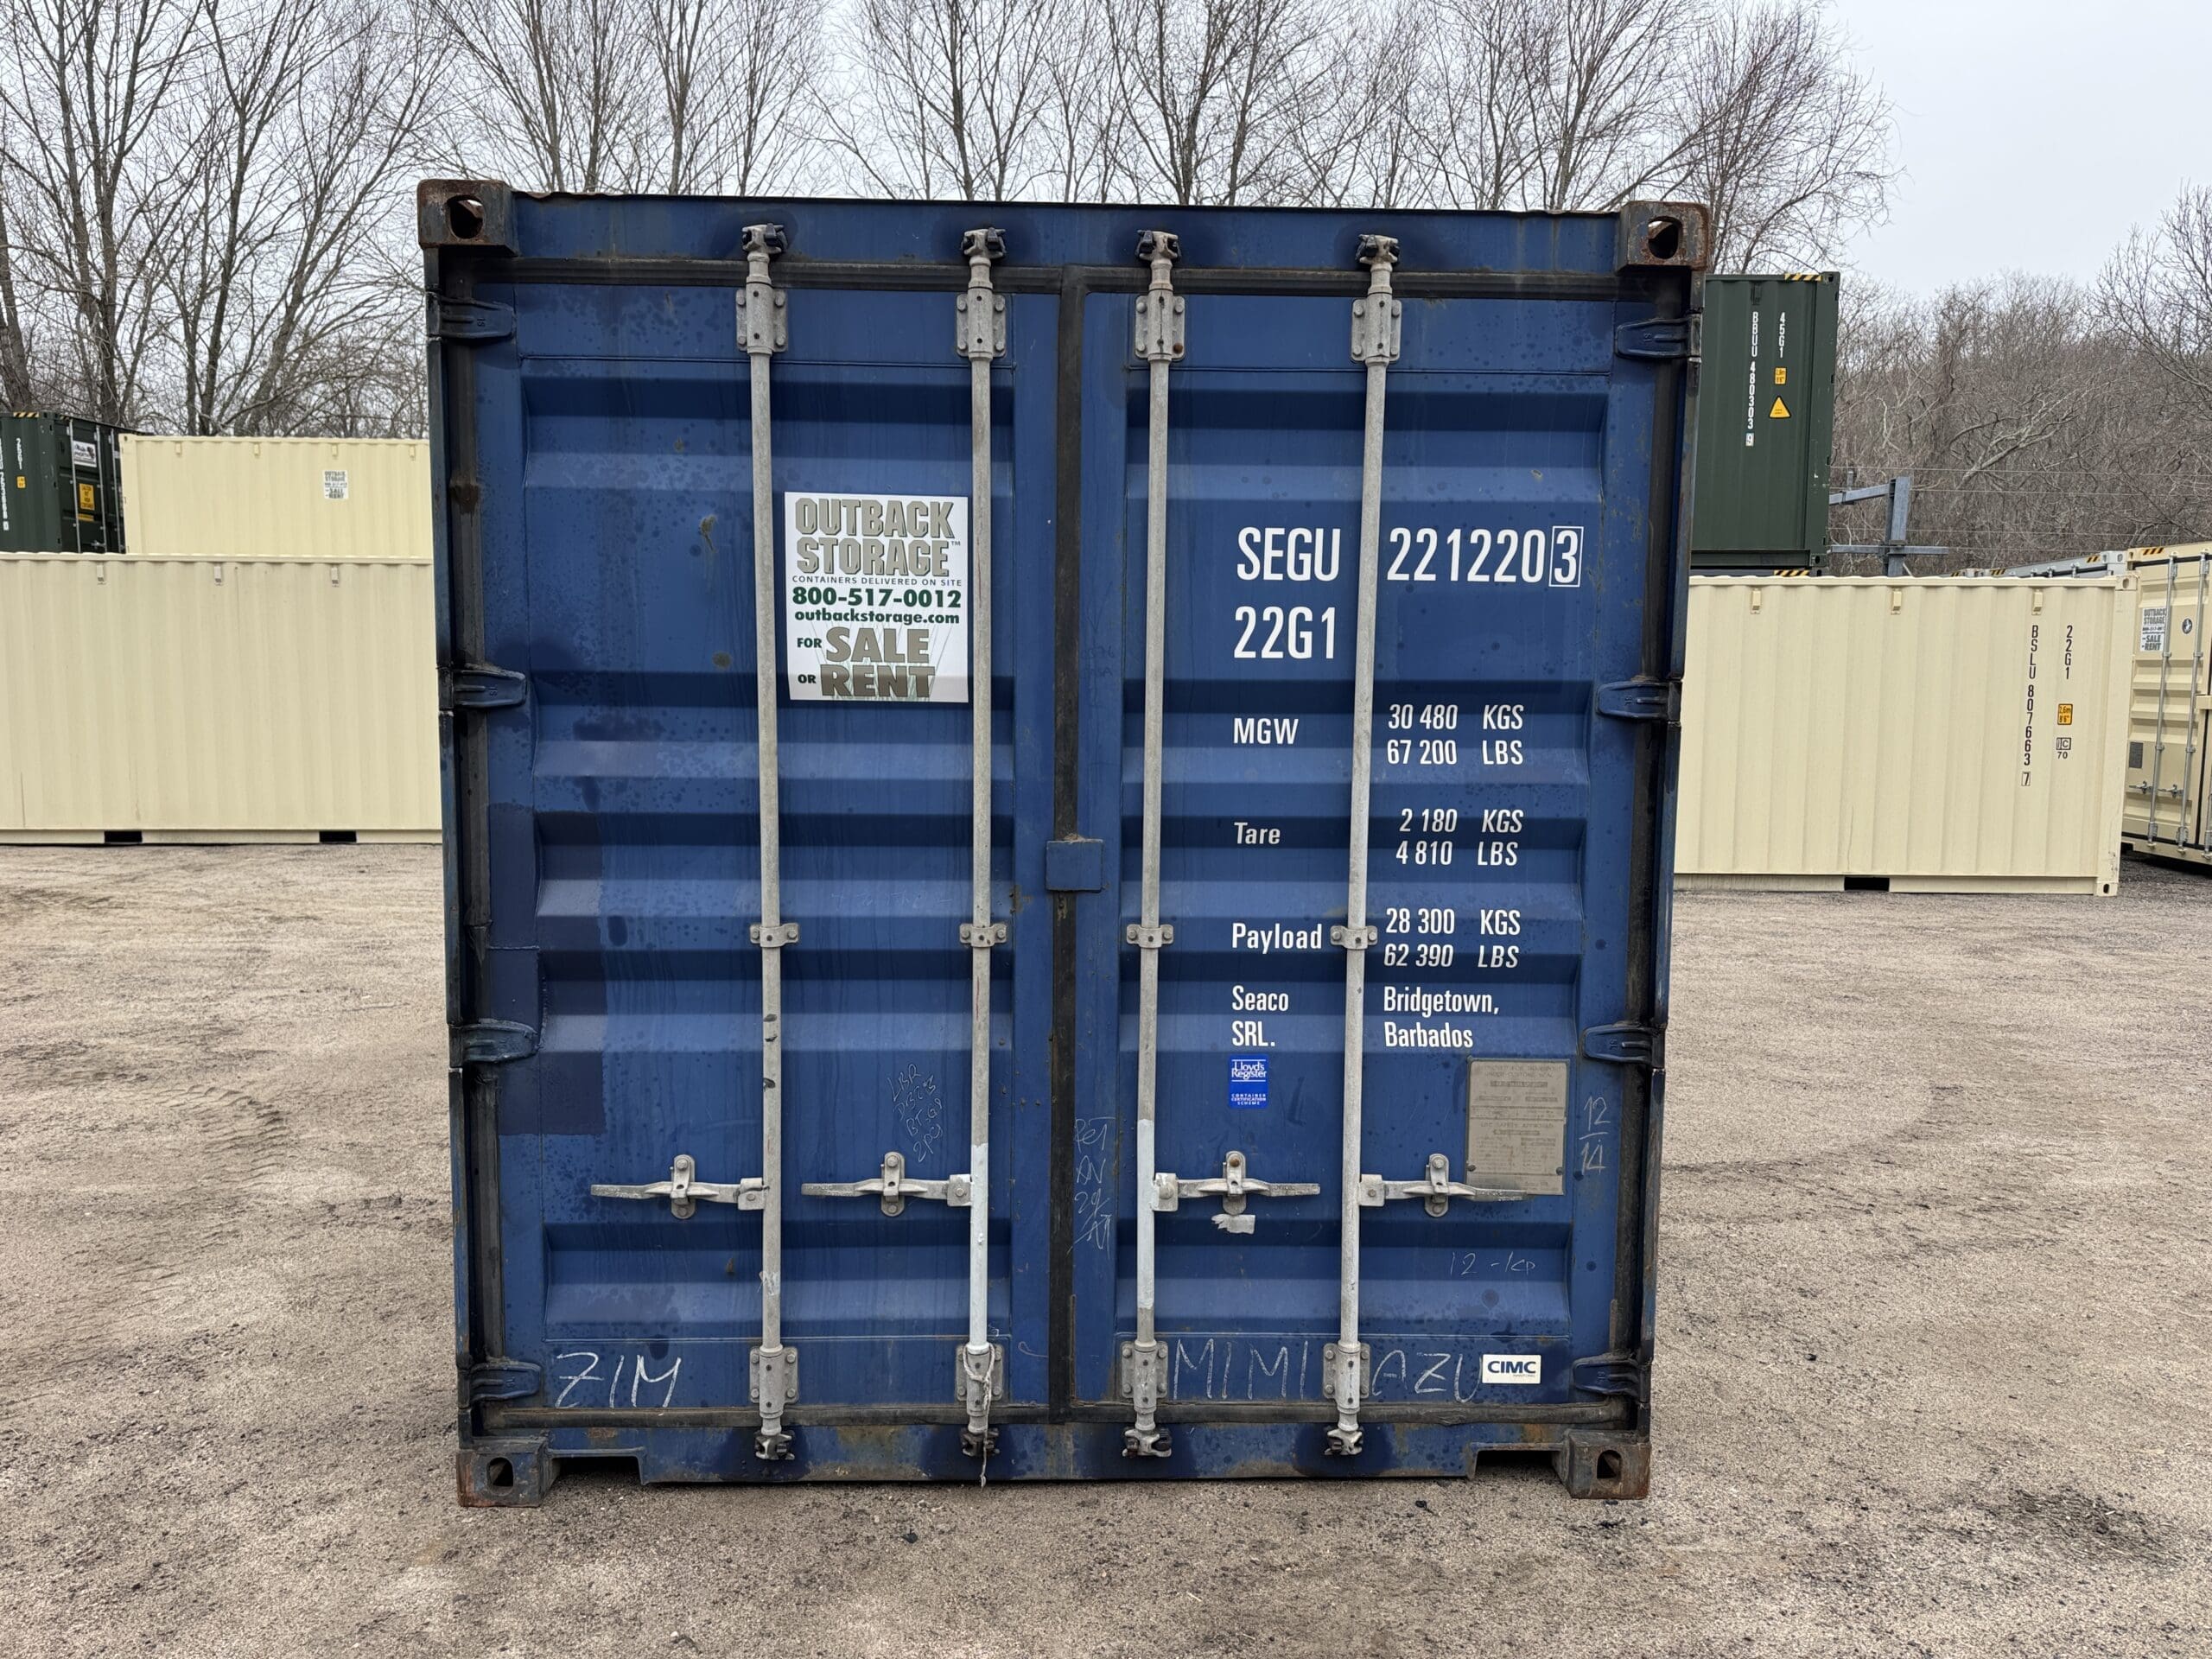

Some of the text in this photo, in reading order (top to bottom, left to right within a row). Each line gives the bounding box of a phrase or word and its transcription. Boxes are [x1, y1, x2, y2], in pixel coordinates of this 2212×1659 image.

[1747, 361, 1756, 429] 480303
[795, 498, 955, 538] OUTBACK
[797, 537, 949, 576] STORAGE
[1236, 527, 1341, 582] SEGU
[792, 575, 857, 584] CONTAINERS
[792, 587, 962, 608] 800-517-0012
[795, 608, 960, 626] outbackstorage.com
[797, 626, 930, 664] FOR SALE
[1234, 606, 1336, 659] 22G1
[2029, 625, 2039, 679] BSLU
[2064, 625, 2073, 679] 22G1
[798, 664, 936, 698] OR RENT
[1233, 717, 1299, 744] MGW
[1388, 704, 1524, 730] 30 480 KGS
[2024, 684, 2034, 766] 807663
[1387, 739, 1523, 765] 67 200 LBS
[1234, 822, 1281, 845] Tare
[1399, 808, 1523, 834] 2 180 KGS
[1395, 841, 1518, 866] 4 810 LBS
[1385, 908, 1521, 936] 28 300 KGS
[1232, 923, 1322, 954] Payload
[1382, 944, 1520, 969] 62 390 LBS
[1231, 985, 1289, 1012] Seaco
[1383, 986, 1500, 1018] Bridgetown,
[1231, 1021, 1275, 1047] SRL.
[1384, 1021, 1473, 1048] Barbados
[1231, 1068, 1267, 1080] Register
[1235, 1061, 1265, 1071] Lloyd's
[1583, 1095, 1611, 1131] 12
[555, 1351, 682, 1409] ZIM
[1488, 1360, 1536, 1374] CIMC
